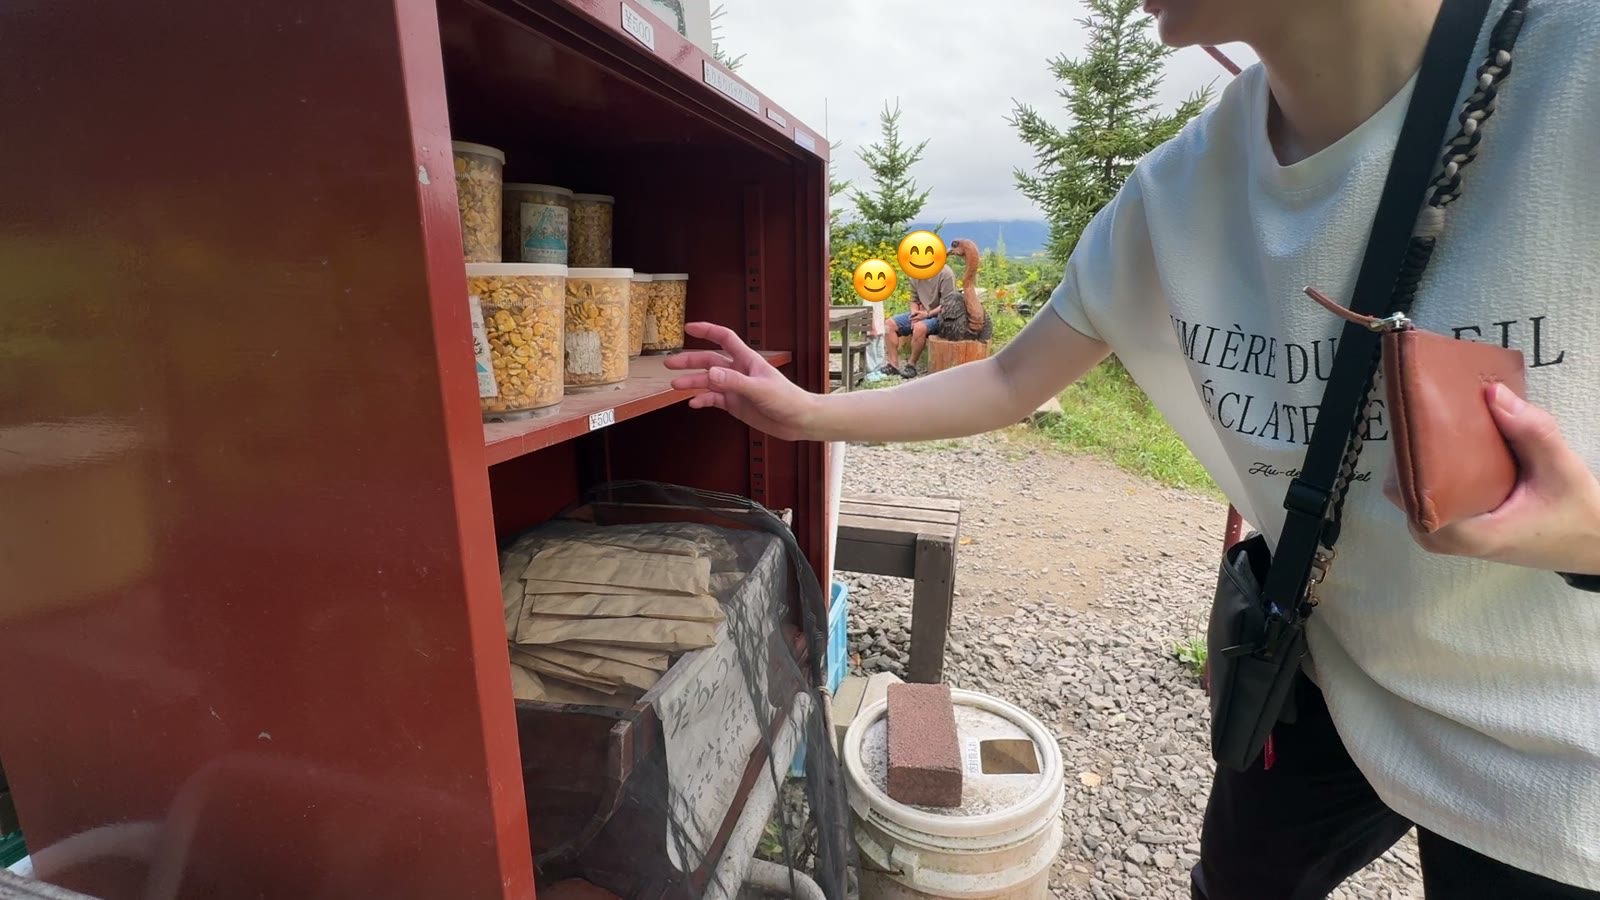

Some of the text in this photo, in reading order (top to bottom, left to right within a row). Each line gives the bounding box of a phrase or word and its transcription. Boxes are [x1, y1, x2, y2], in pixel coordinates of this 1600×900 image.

[624, 8, 650, 42] ¥500
[1284, 337, 1337, 385] DU
[590, 410, 614, 428] ¥500
